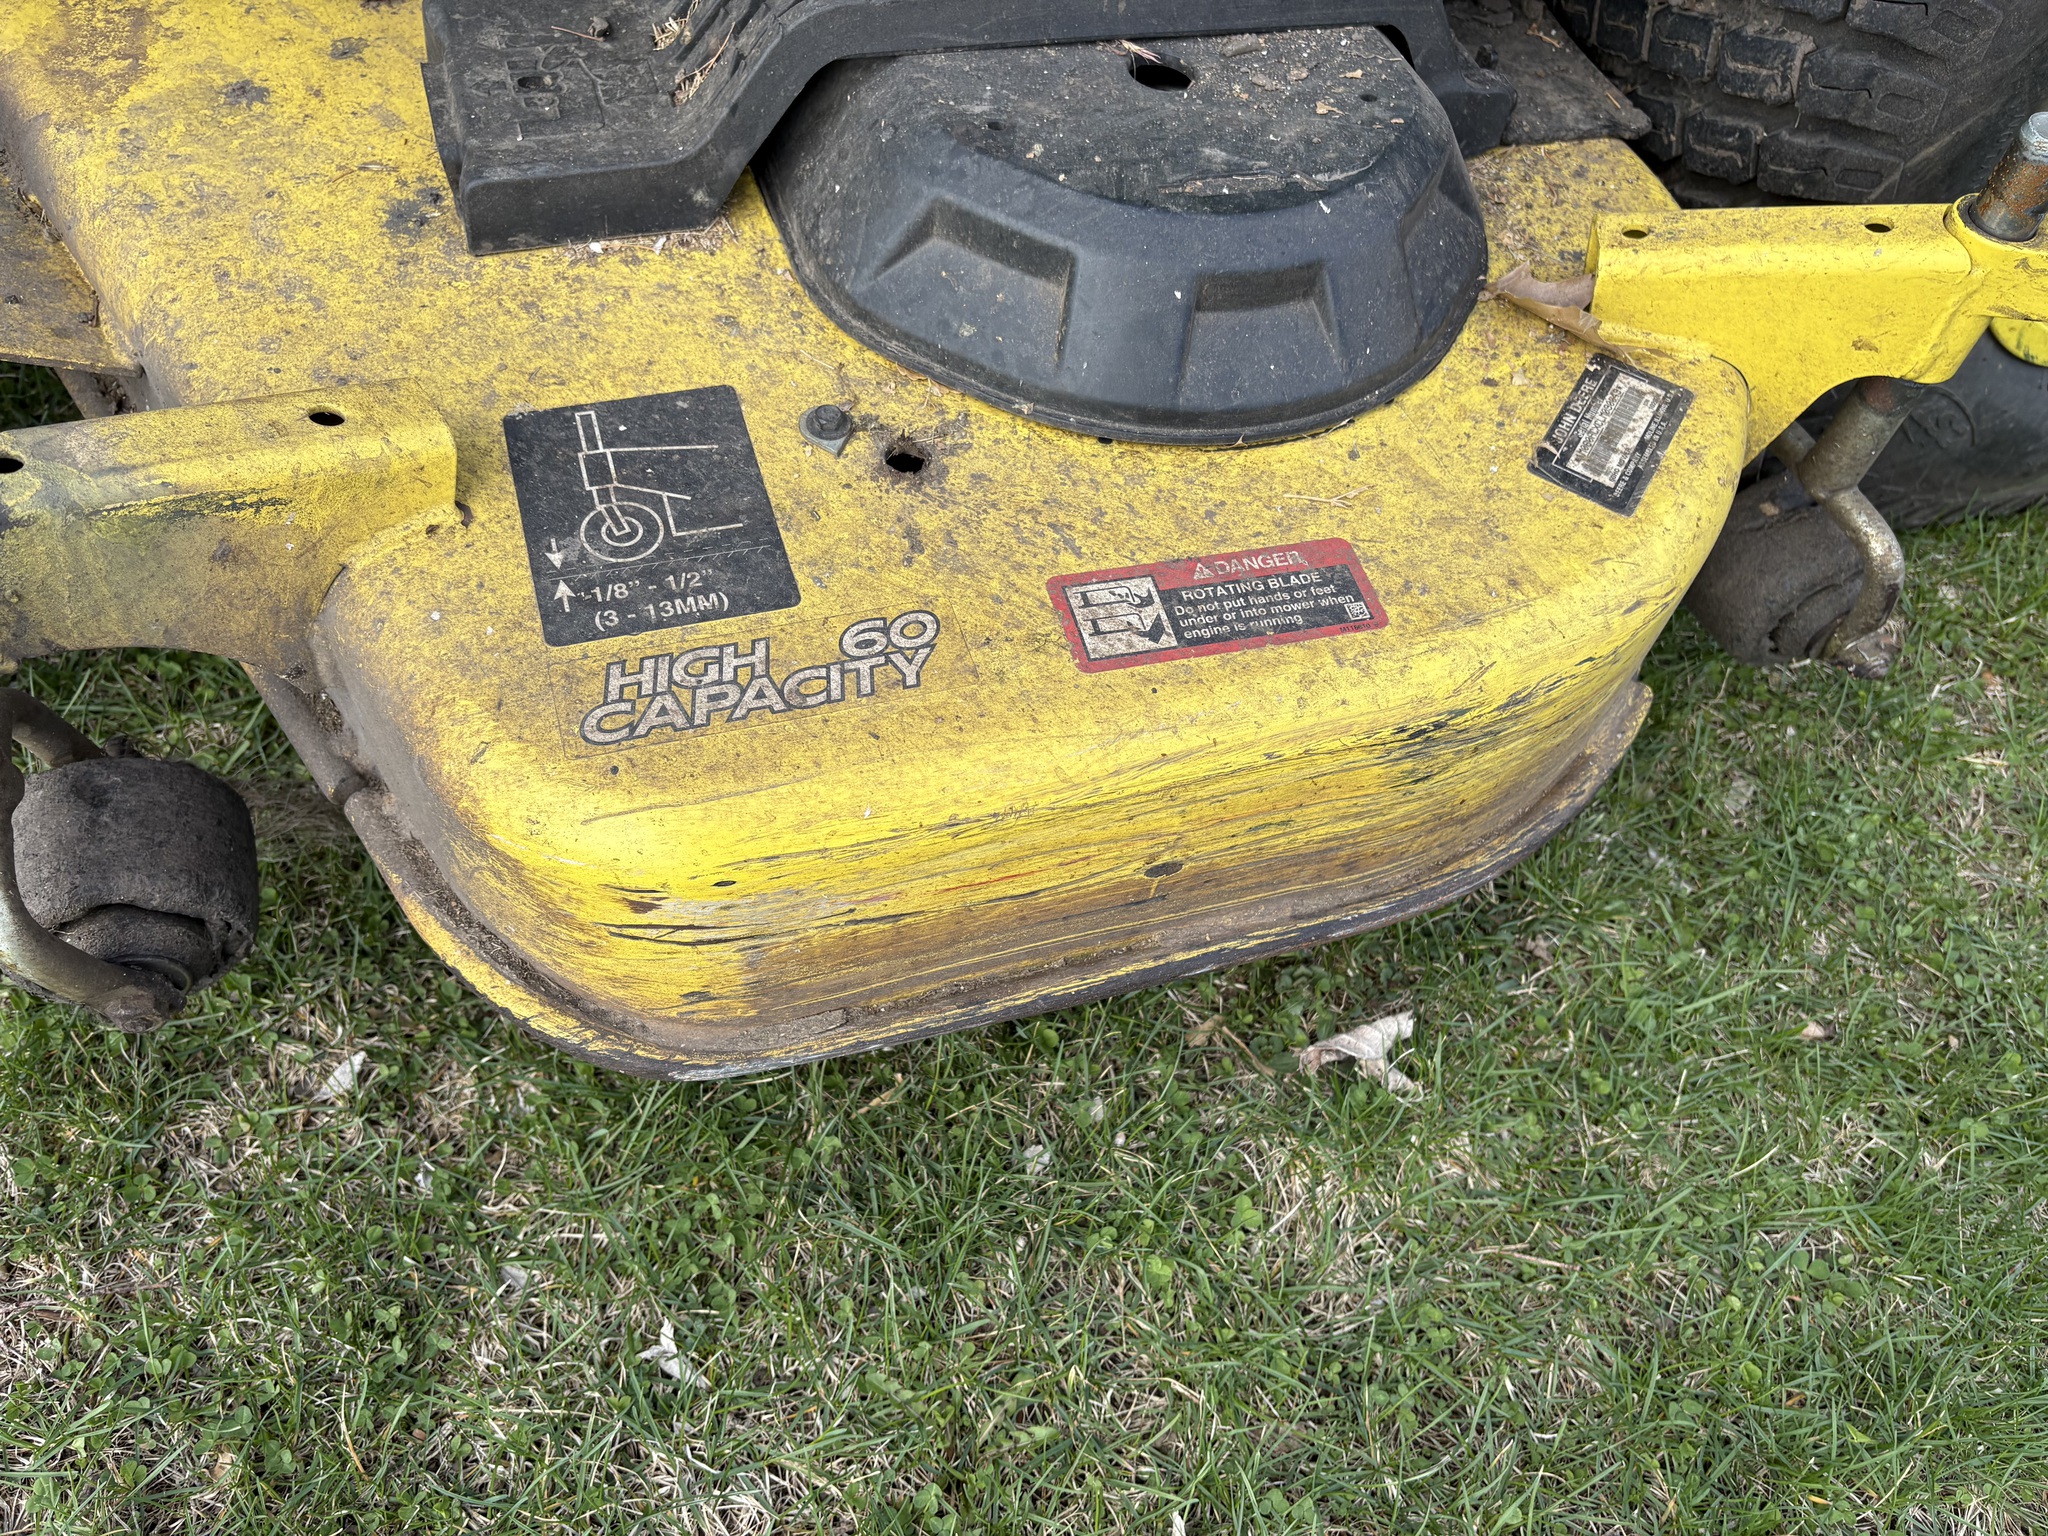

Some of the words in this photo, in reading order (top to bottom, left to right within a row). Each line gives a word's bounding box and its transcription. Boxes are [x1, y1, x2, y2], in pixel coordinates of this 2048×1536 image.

[1552, 411, 1577, 444] JOHN
[1571, 378, 1598, 413] DEERE
[1213, 550, 1309, 575] DANGER
[1174, 605, 1195, 616] Do
[1197, 600, 1221, 613] not
[1223, 597, 1247, 612] put
[1247, 591, 1291, 606] hands
[1294, 589, 1308, 599] or
[1310, 584, 1337, 597] feet
[1181, 580, 1265, 601] ROTATING
[1267, 571, 1323, 589] BLADE
[594, 609, 620, 632] (3
[645, 591, 729, 620] 13MM)
[1179, 614, 1219, 628] under
[1223, 611, 1237, 622] or
[1240, 607, 1267, 619] into
[1270, 600, 1315, 615] mower
[1318, 594, 1355, 608] when
[1183, 625, 1232, 639] engine
[1234, 621, 1247, 632] is
[1250, 614, 1304, 628] running
[604, 637, 770, 702] HIGH
[838, 610, 941, 660] 60
[579, 643, 936, 746] CAPACITY
